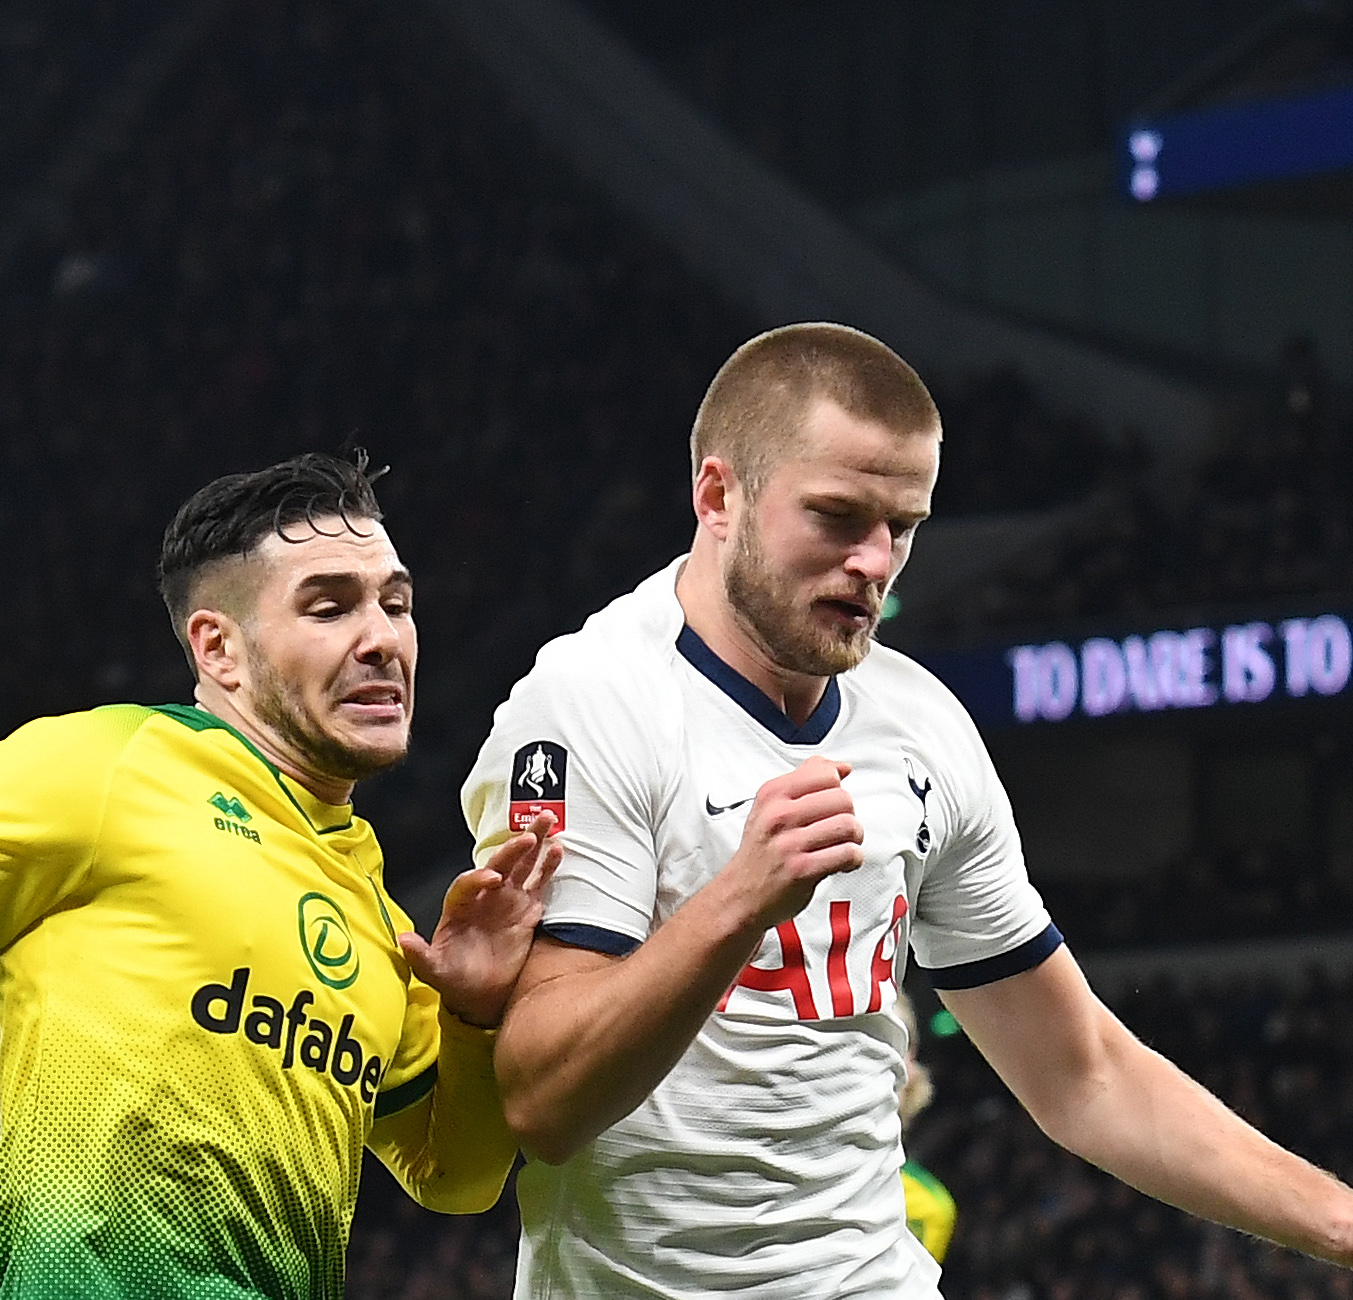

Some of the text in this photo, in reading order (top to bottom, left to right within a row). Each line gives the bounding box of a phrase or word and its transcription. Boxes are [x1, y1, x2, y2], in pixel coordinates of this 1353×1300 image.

[1006, 640, 1078, 721] TO
[1082, 627, 1218, 716] DARE
[1222, 621, 1277, 704] IS
[1278, 613, 1352, 697] TO
[190, 967, 382, 1105] dafabe
